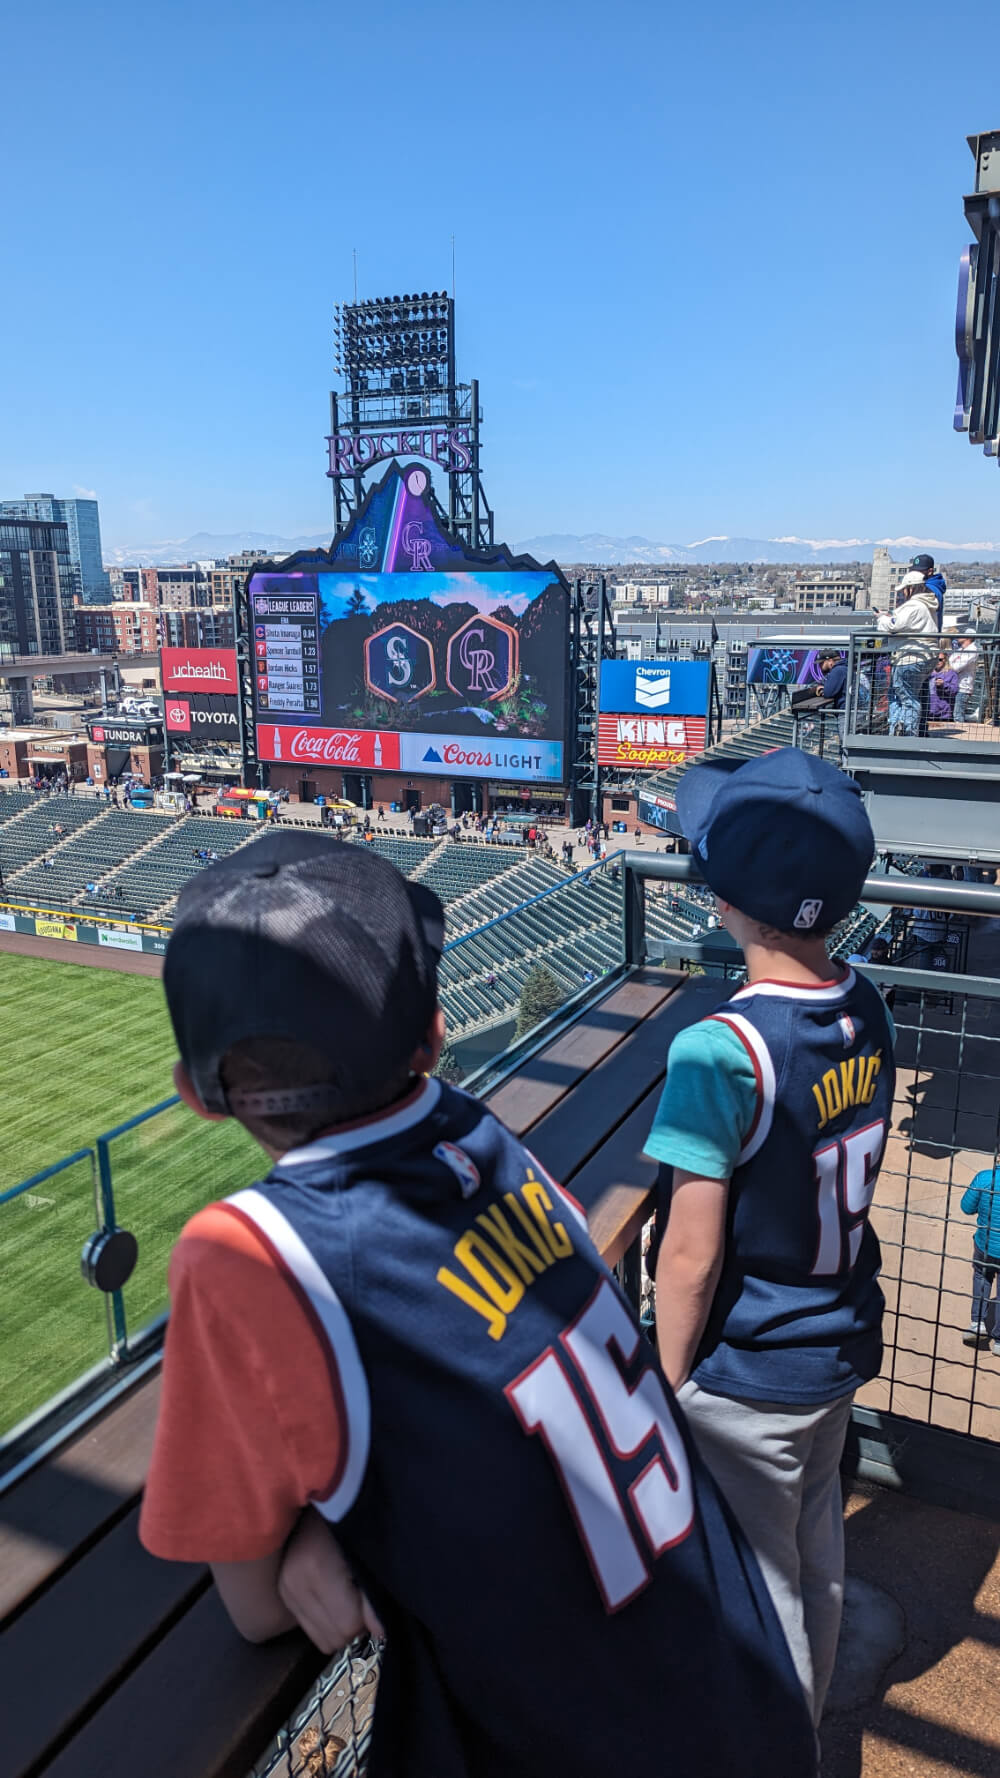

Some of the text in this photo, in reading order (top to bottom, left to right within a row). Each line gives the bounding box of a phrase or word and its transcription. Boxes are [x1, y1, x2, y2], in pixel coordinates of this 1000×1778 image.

[324, 428, 471, 475] ROCKIES
[269, 600, 314, 613] LEAGUE LEADERS
[172, 660, 226, 679] uchealth
[304, 665, 316, 674] 1.57
[635, 666, 671, 677] Chevron
[190, 710, 238, 726] TOYOTA
[103, 729, 143, 742] TUNDRA
[616, 719, 686, 745] KING
[290, 730, 362, 762] Coca-Cola
[442, 743, 542, 770] Coors LIGHT
[616, 741, 686, 767] Soopers
[811, 1048, 883, 1130] JOKIĆ
[809, 1118, 886, 1277] 15
[436, 1167, 575, 1342] JOKIĆ
[503, 1274, 697, 1616] 15
